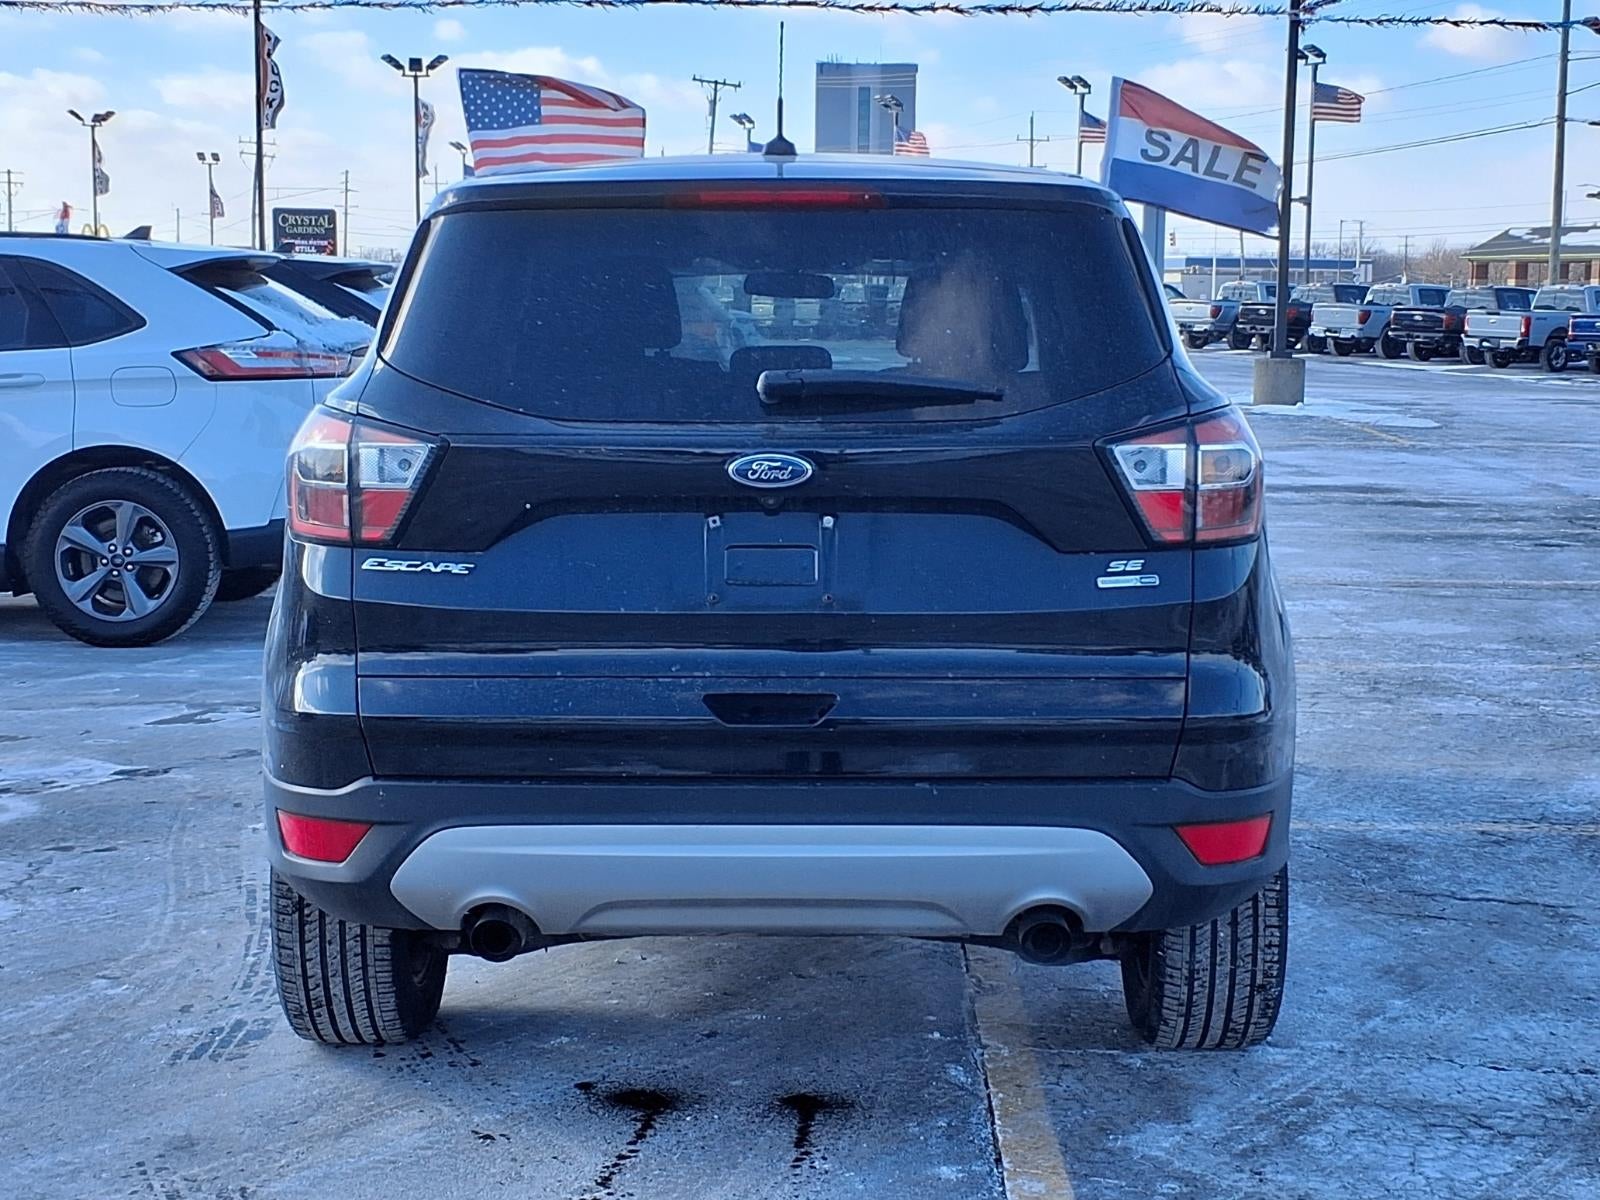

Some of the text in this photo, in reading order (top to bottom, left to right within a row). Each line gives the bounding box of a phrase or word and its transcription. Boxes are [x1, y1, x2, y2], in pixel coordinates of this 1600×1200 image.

[1140, 128, 1269, 190] SALE
[278, 213, 334, 228] CRYSTAL
[285, 226, 326, 235] GARDENS
[747, 460, 793, 480] Ford
[361, 557, 475, 575] ESCAPE
[1106, 559, 1145, 572] SE
